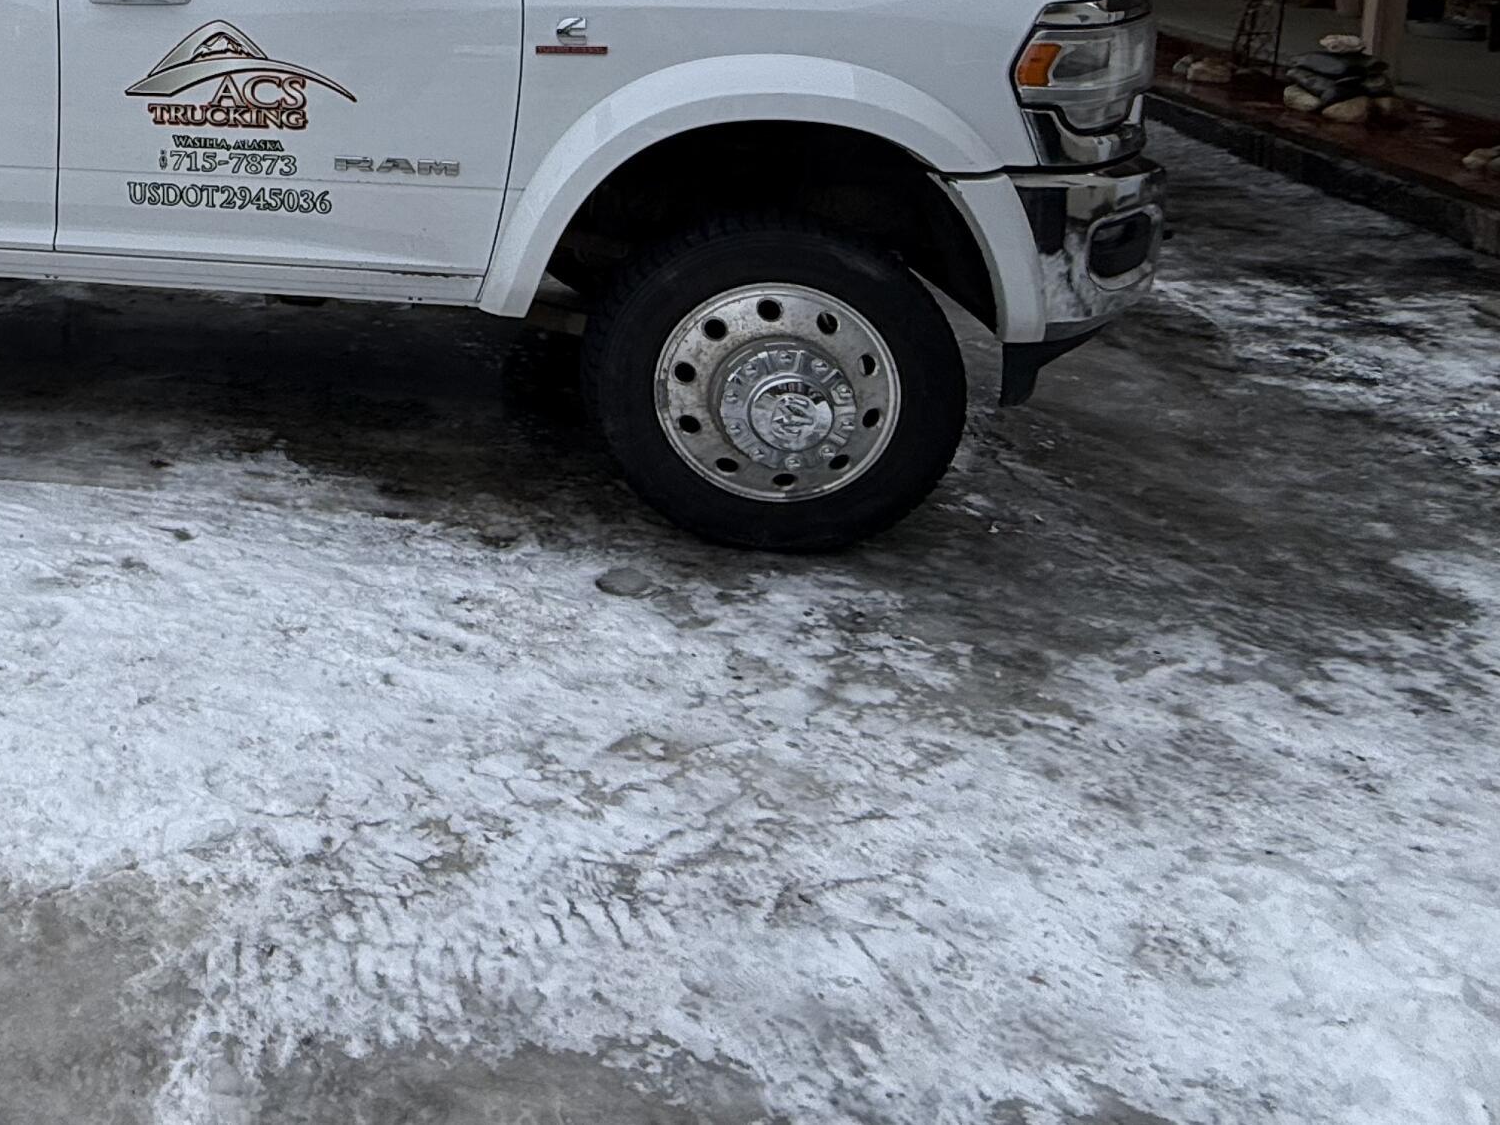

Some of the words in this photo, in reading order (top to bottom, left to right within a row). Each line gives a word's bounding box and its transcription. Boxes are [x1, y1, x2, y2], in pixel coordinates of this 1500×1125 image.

[209, 75, 307, 110] ACS
[148, 103, 309, 129] TRUCKING
[233, 139, 285, 152] ALASKA
[170, 150, 298, 176] 715-7873
[333, 155, 461, 177] RAM
[127, 181, 333, 214] USDOT2945036
